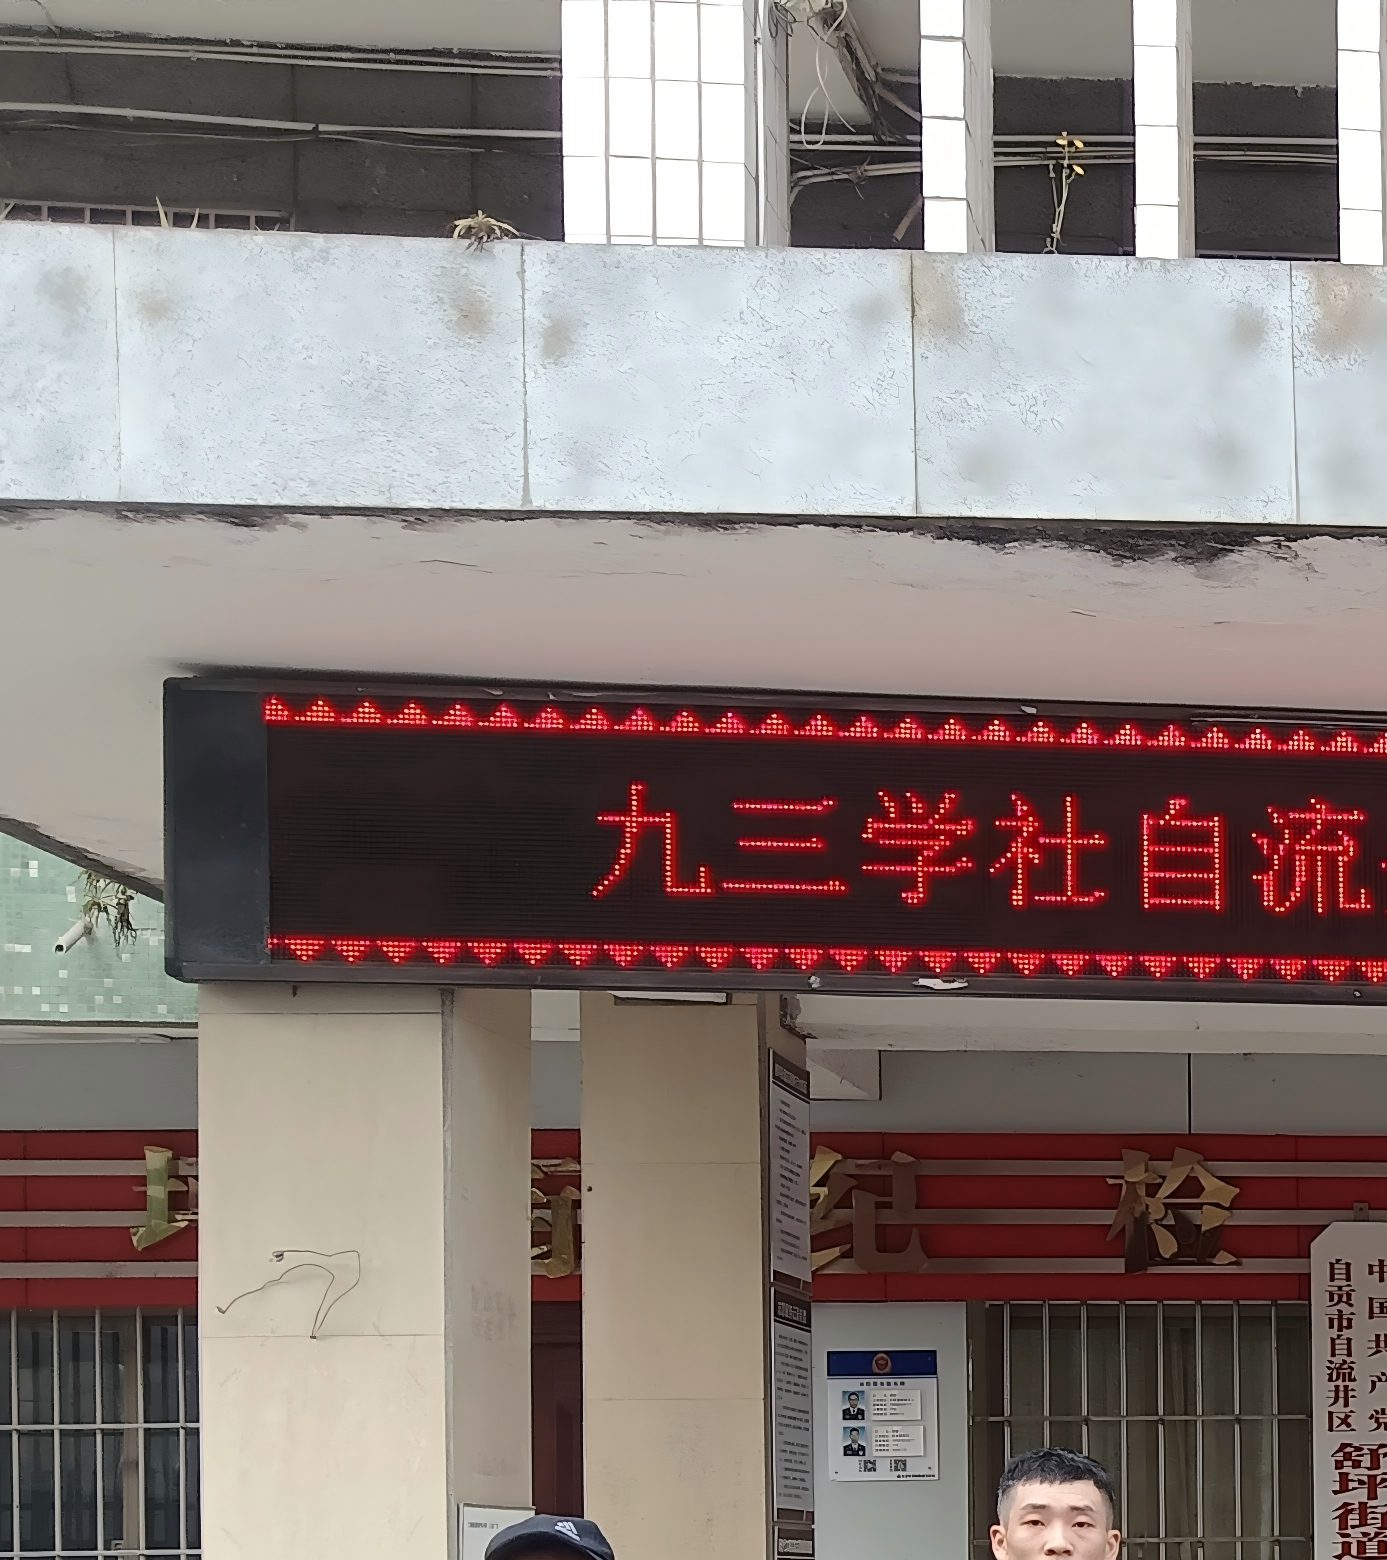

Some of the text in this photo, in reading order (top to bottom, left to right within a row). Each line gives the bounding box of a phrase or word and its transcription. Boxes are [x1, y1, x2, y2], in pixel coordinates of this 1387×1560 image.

[1325, 1258, 1357, 1432] 自贡市自流井区
